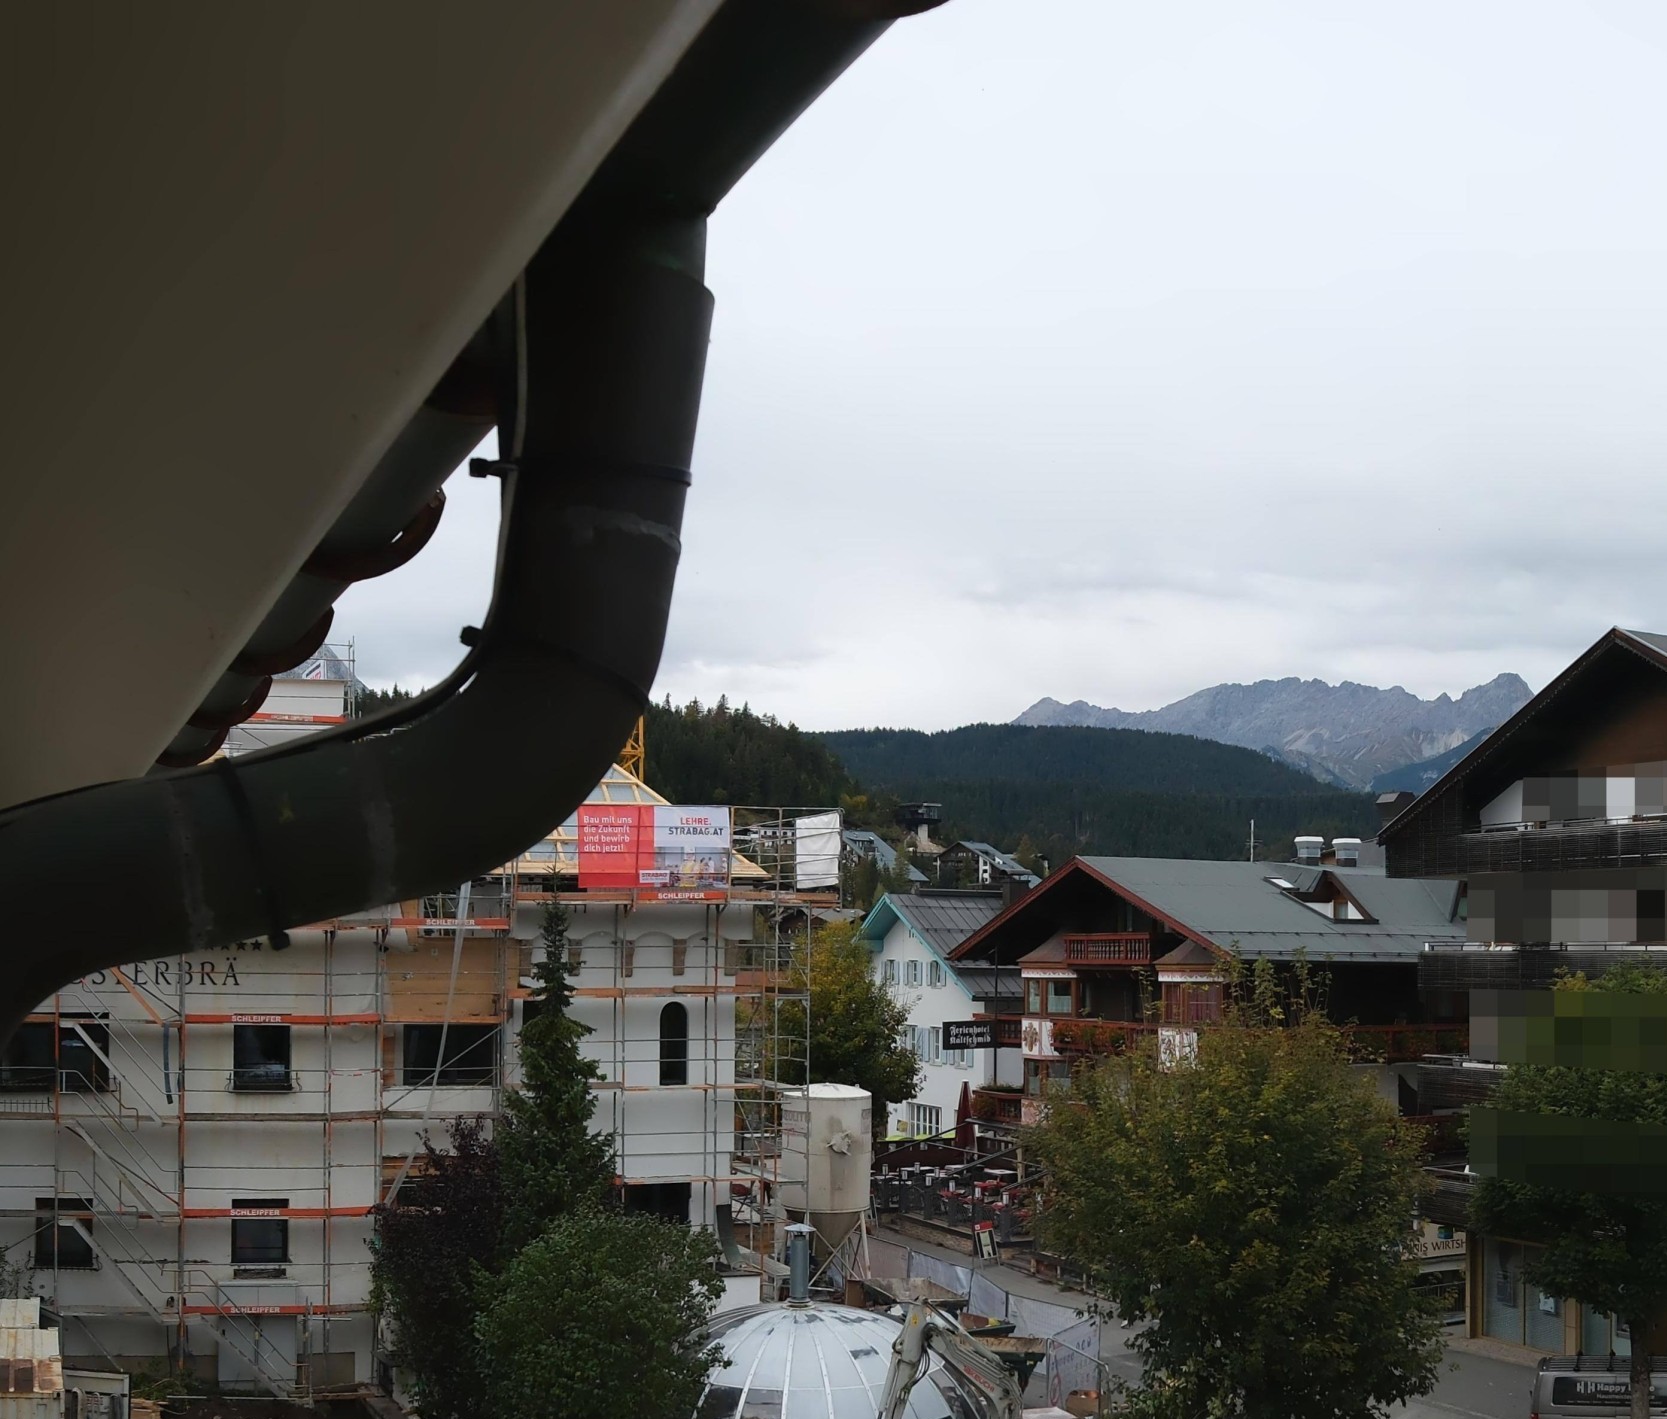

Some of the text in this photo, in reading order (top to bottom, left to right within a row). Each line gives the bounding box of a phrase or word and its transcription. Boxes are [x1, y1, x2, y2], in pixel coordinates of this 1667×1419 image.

[583, 815, 632, 824] Bau mit uns
[680, 817, 712, 826] LEHRE.
[583, 824, 630, 833] die Zukunft
[668, 826, 724, 837] STRABAG.AT
[583, 834, 630, 843] und bewirb
[583, 843, 624, 854] dich jetzt!
[657, 892, 705, 900] SCHLEIPFER
[231, 1015, 282, 1023] SCHLEIPFER
[949, 1024, 990, 1036] Ferienhotel
[230, 1306, 281, 1314] SCHLEIPFER
[1596, 1383, 1626, 1393] Happy
